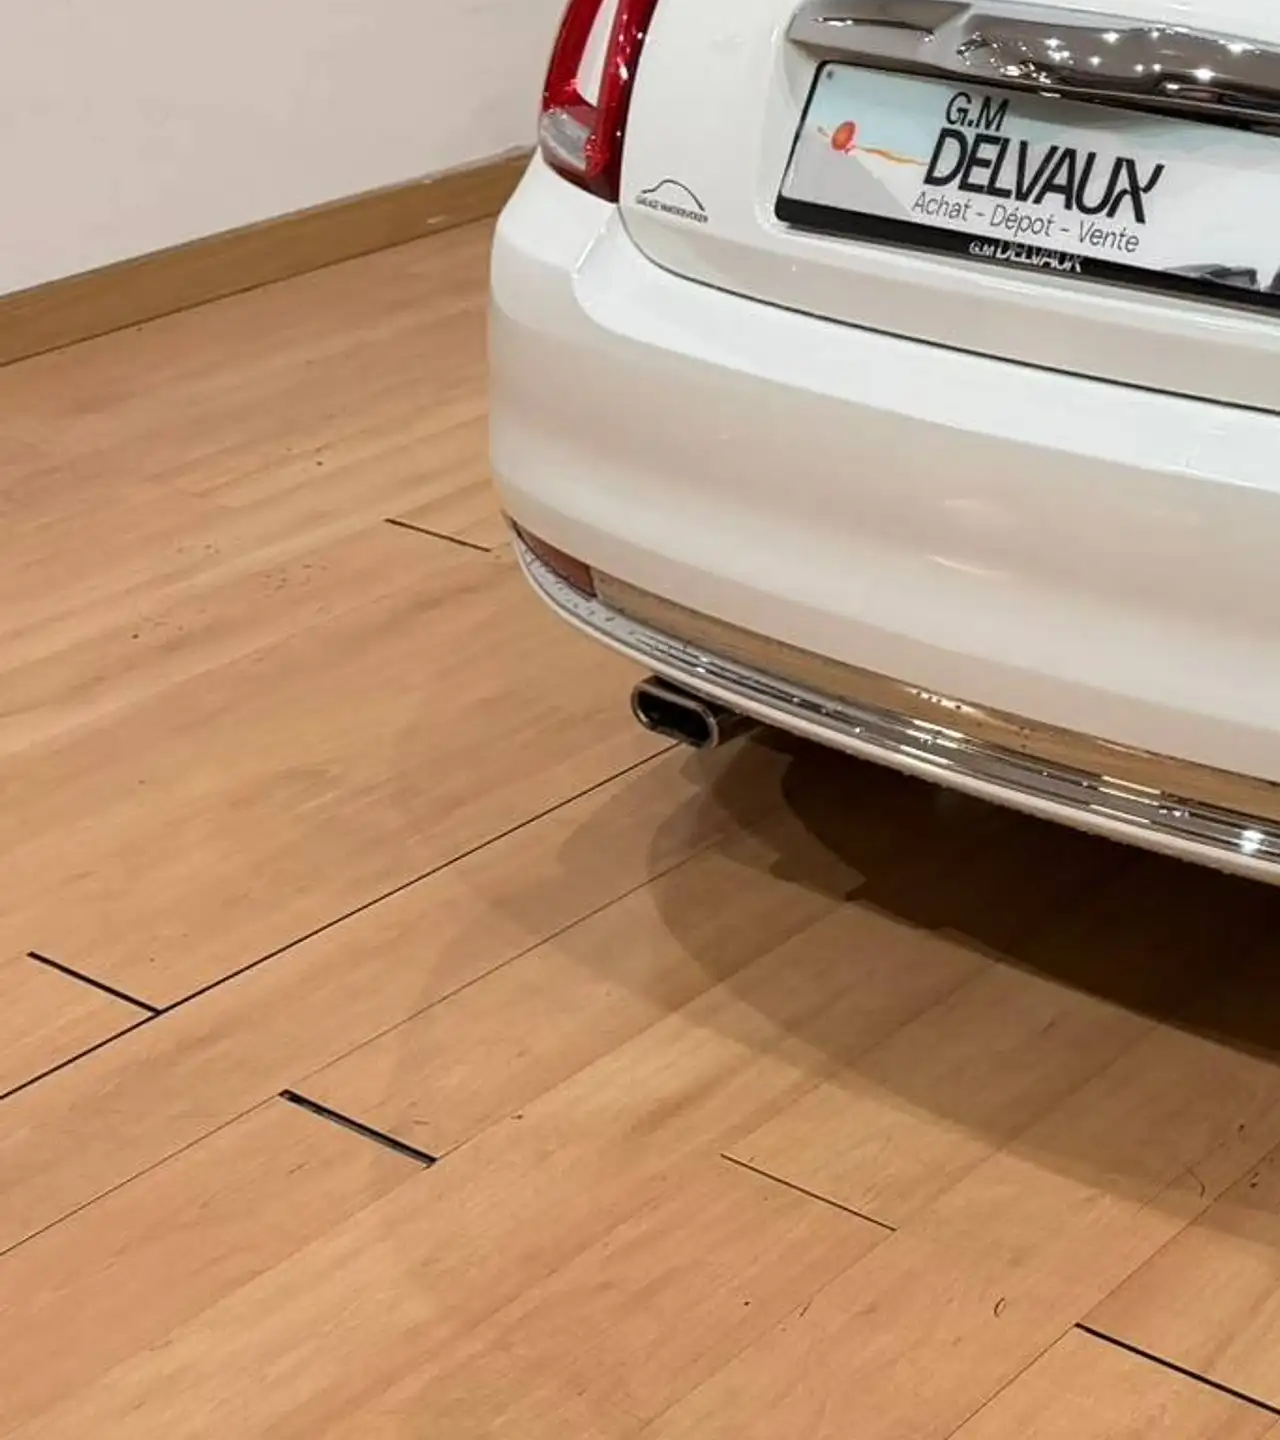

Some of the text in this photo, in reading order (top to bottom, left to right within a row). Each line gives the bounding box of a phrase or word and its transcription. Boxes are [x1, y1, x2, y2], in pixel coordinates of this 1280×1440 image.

[945, 91, 1010, 133] G.M
[923, 127, 1166, 225] DELVAUX
[911, 190, 973, 222] Achat
[990, 203, 1058, 238] Dépot
[1078, 221, 1140, 253] Vente
[995, 239, 1084, 273] DELVAUX
